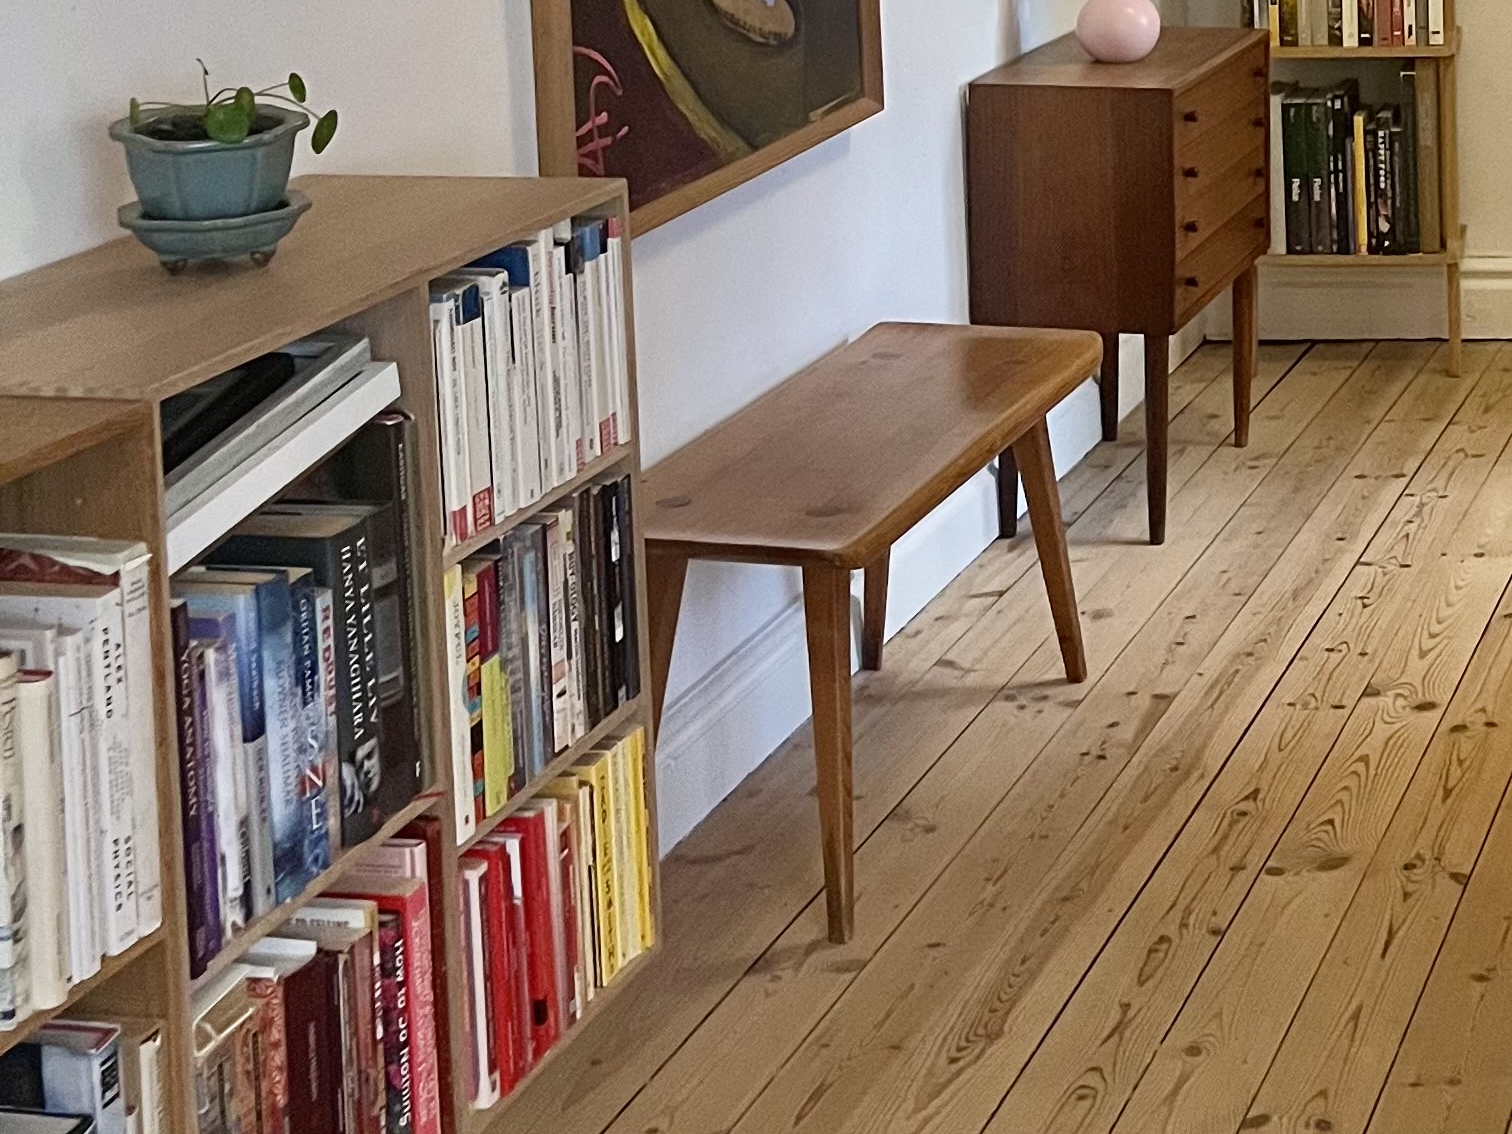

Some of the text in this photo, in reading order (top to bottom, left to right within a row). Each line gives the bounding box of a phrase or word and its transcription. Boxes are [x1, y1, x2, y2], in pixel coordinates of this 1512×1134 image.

[114, 642, 124, 685] ALEX
[299, 598, 312, 656] ORHAN
[340, 545, 366, 741] HANYA YANAGIHARA
[356, 537, 379, 724] ET LILLE LIV
[101, 626, 114, 720] PENTLAND
[181, 648, 198, 818] YOGA ANATOMY
[112, 837, 124, 913] PHYSICS
[123, 835, 136, 902] SOCIAL
[394, 939, 406, 982] How
[397, 987, 407, 1009] to
[399, 1046, 412, 1126] Nothing
